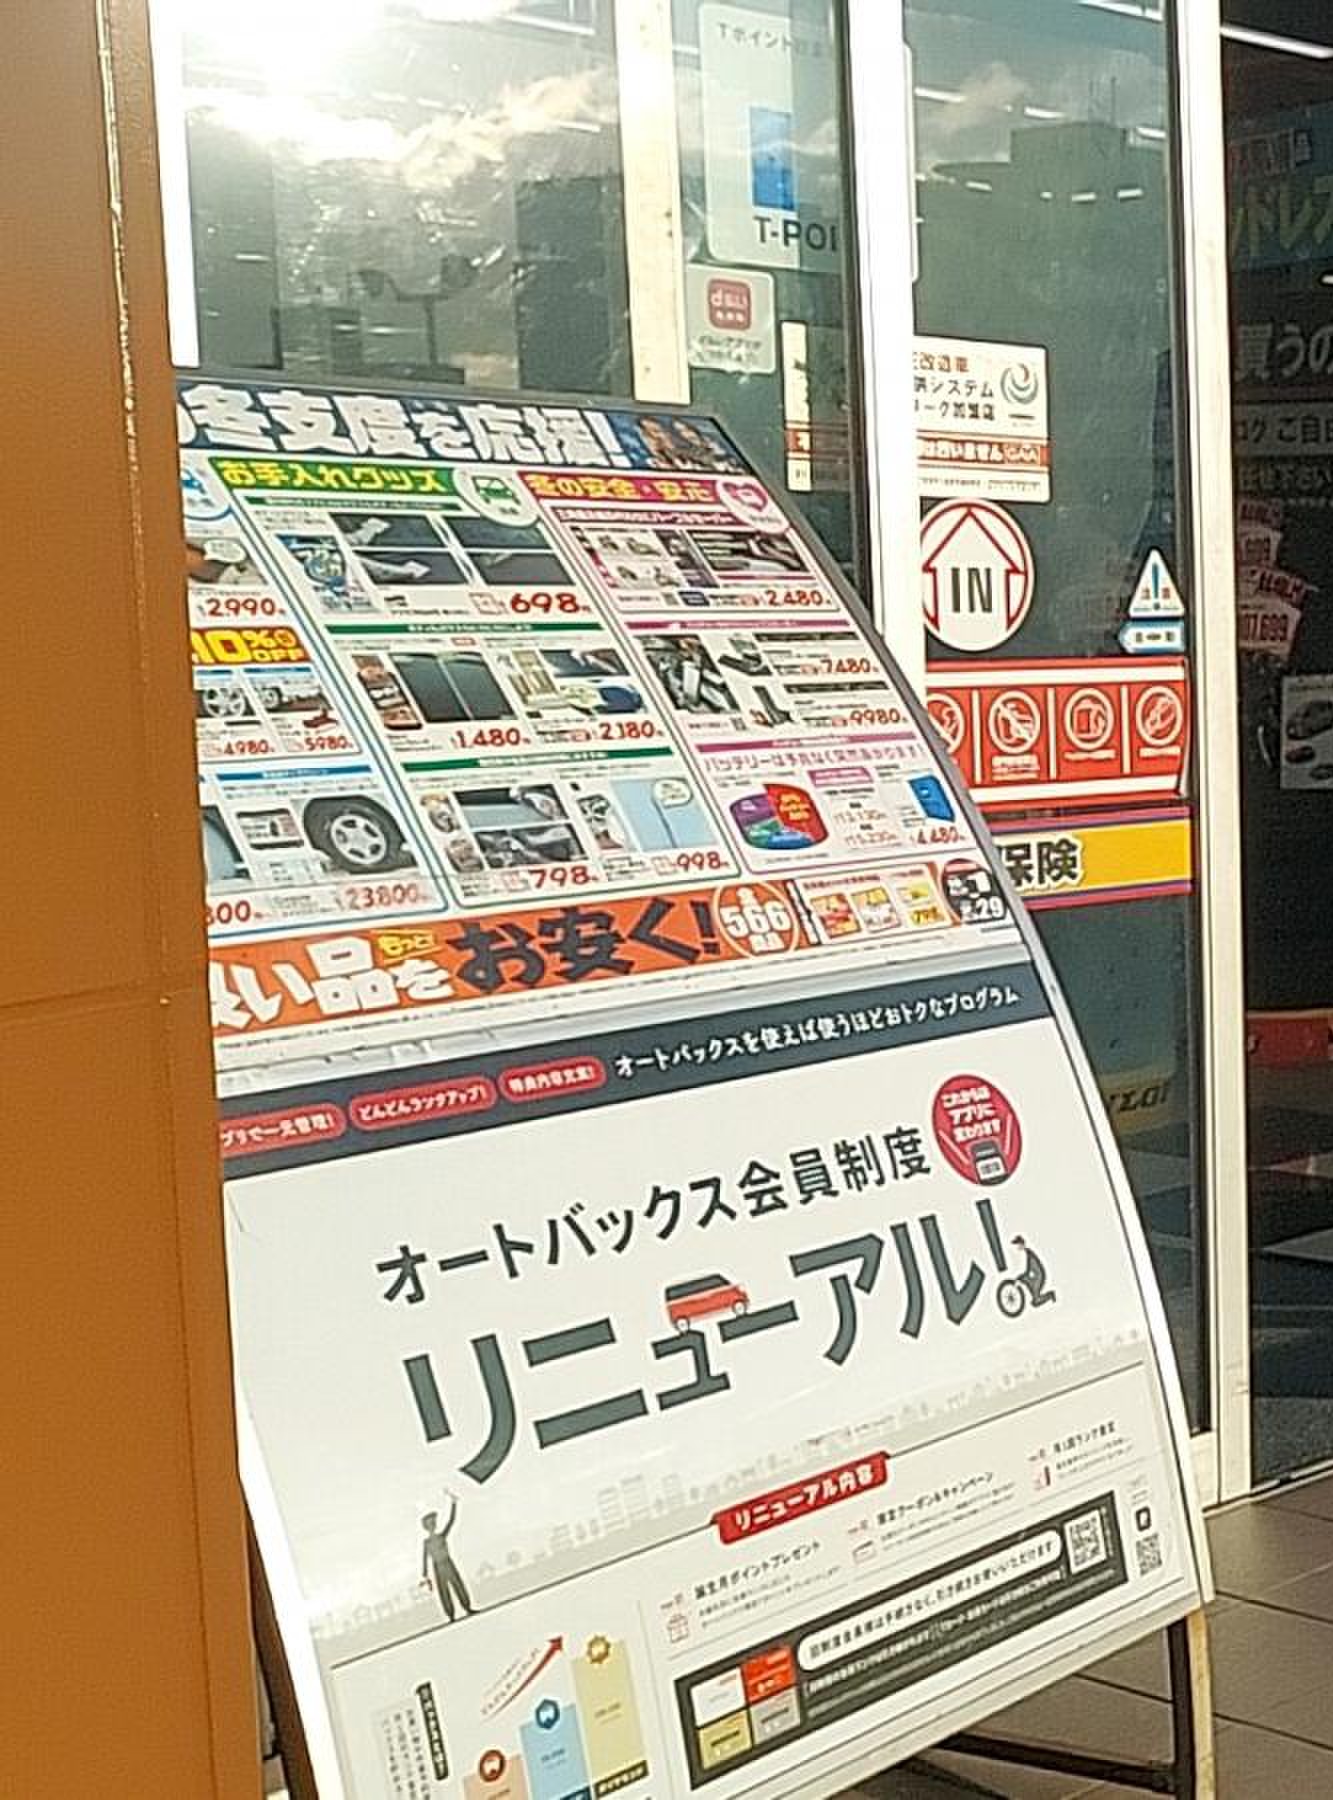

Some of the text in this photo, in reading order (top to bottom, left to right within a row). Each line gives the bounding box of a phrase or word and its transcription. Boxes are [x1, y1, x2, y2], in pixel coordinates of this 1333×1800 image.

[216, 460, 448, 494] お手入れグッズ
[950, 566, 993, 614] IN
[446, 898, 721, 993] お安く!
[614, 985, 1020, 1078] オートバックスを使えば使うほどおトクなプログラム
[376, 1126, 932, 1304] オートバックス会員制度
[402, 1198, 1008, 1485] リニューアル!
[734, 1463, 875, 1531] リニューアル内容
